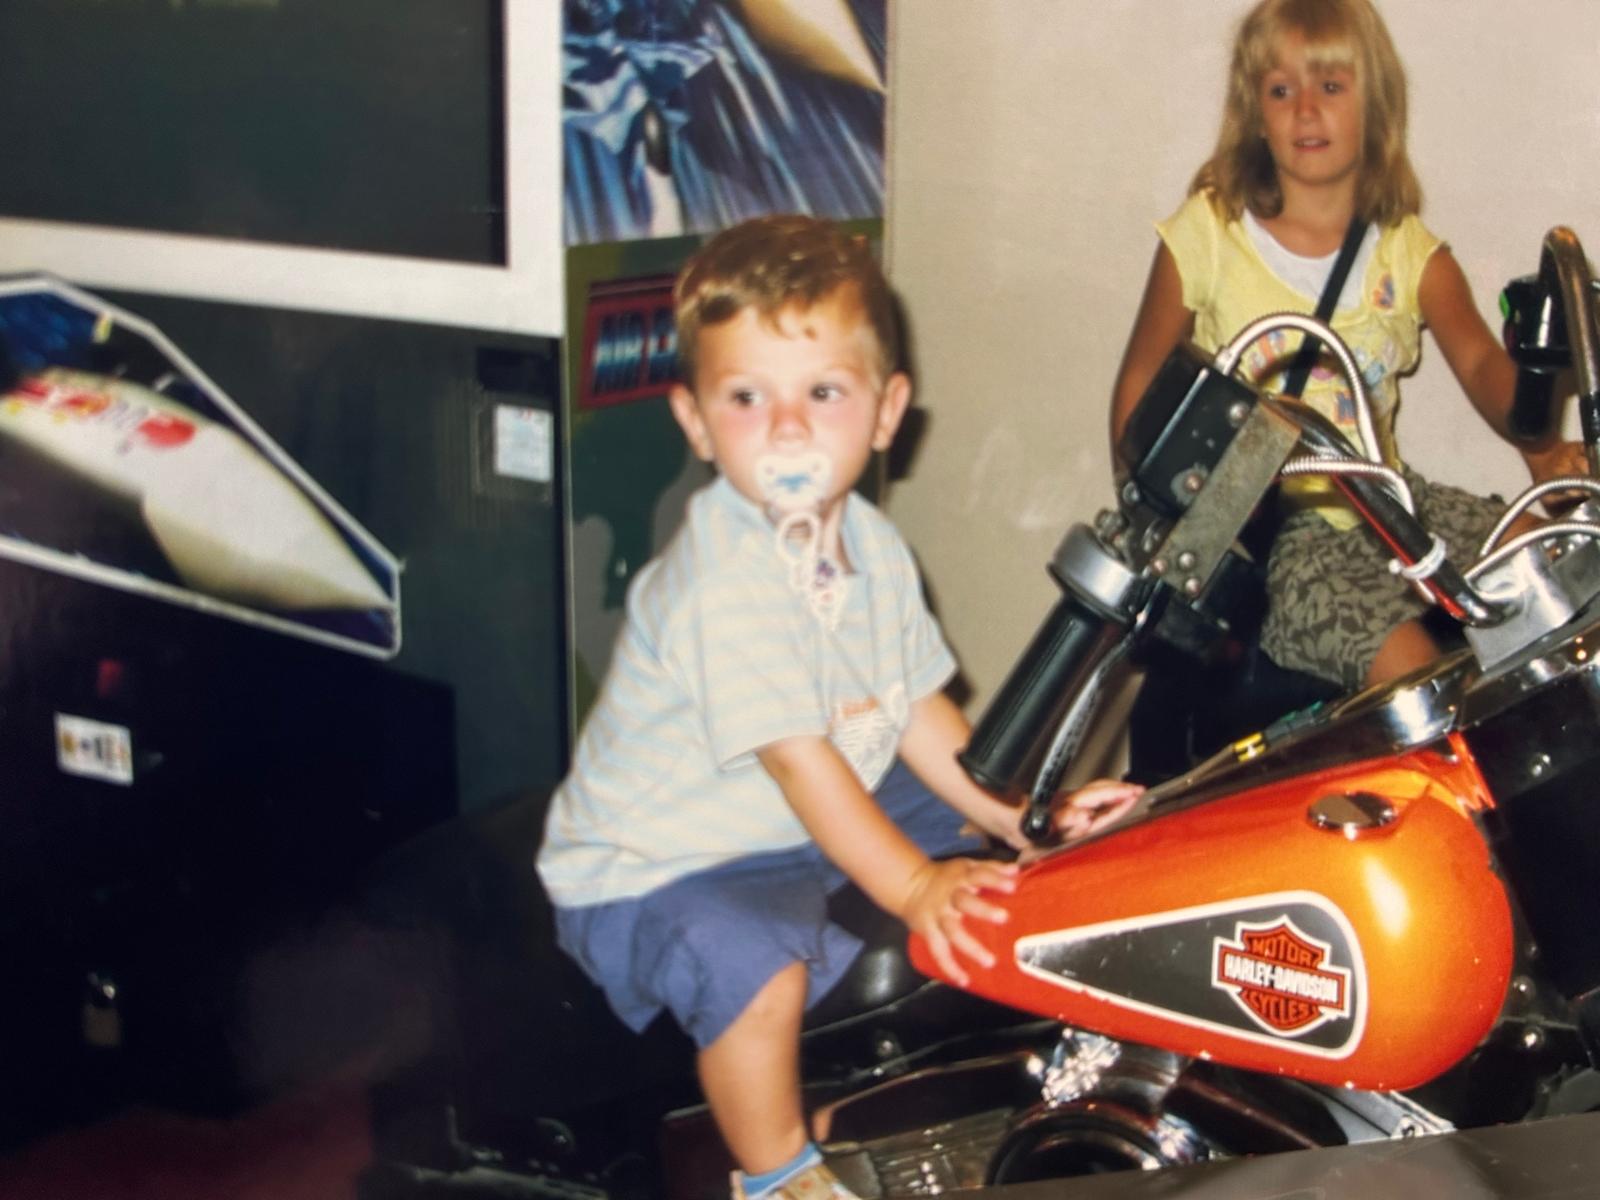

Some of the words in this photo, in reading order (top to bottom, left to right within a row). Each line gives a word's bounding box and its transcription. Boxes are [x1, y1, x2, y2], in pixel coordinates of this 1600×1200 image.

[1252, 934, 1313, 967] MOTOR
[1224, 953, 1338, 1003] HARLEY-DAVIDSON
[1251, 993, 1307, 1024] CYCLES
